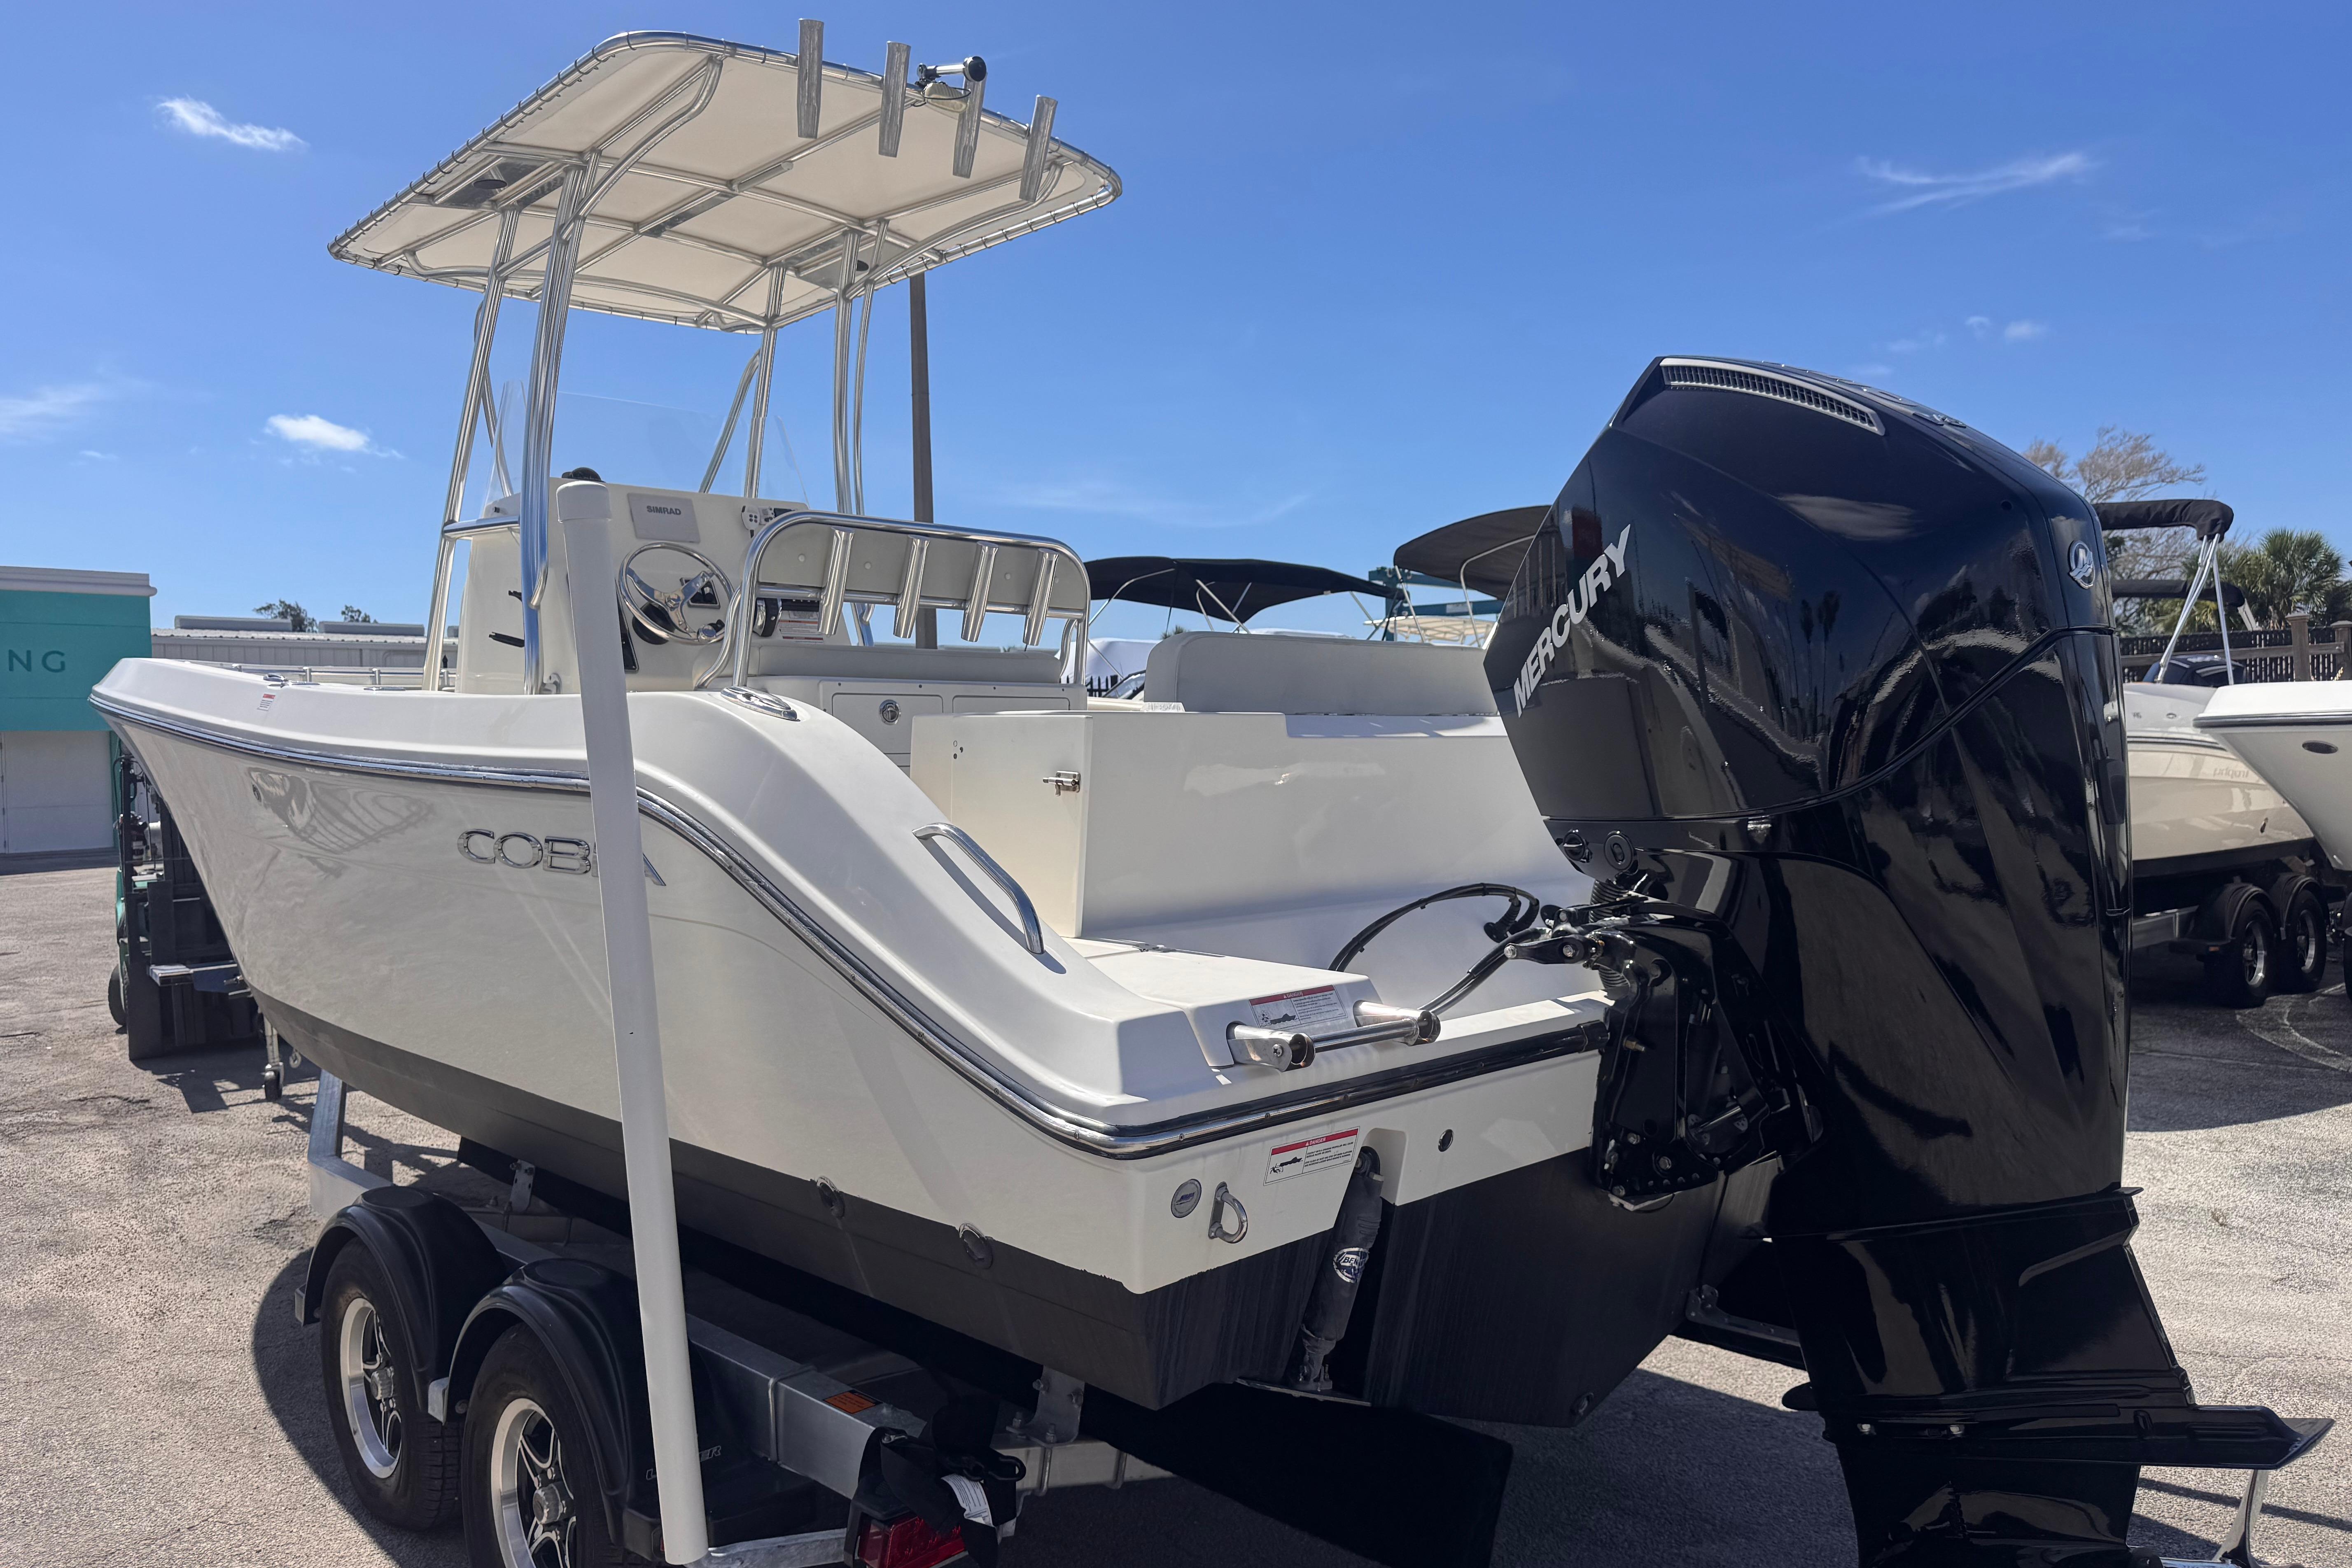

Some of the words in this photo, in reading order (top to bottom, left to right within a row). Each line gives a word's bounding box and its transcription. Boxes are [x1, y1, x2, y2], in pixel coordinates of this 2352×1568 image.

[646, 506, 681, 515] SIMRAD
[1514, 524, 1630, 718] MERCURY
[8, 649, 65, 673] NG
[1309, 1137, 1326, 1145] DANGER
